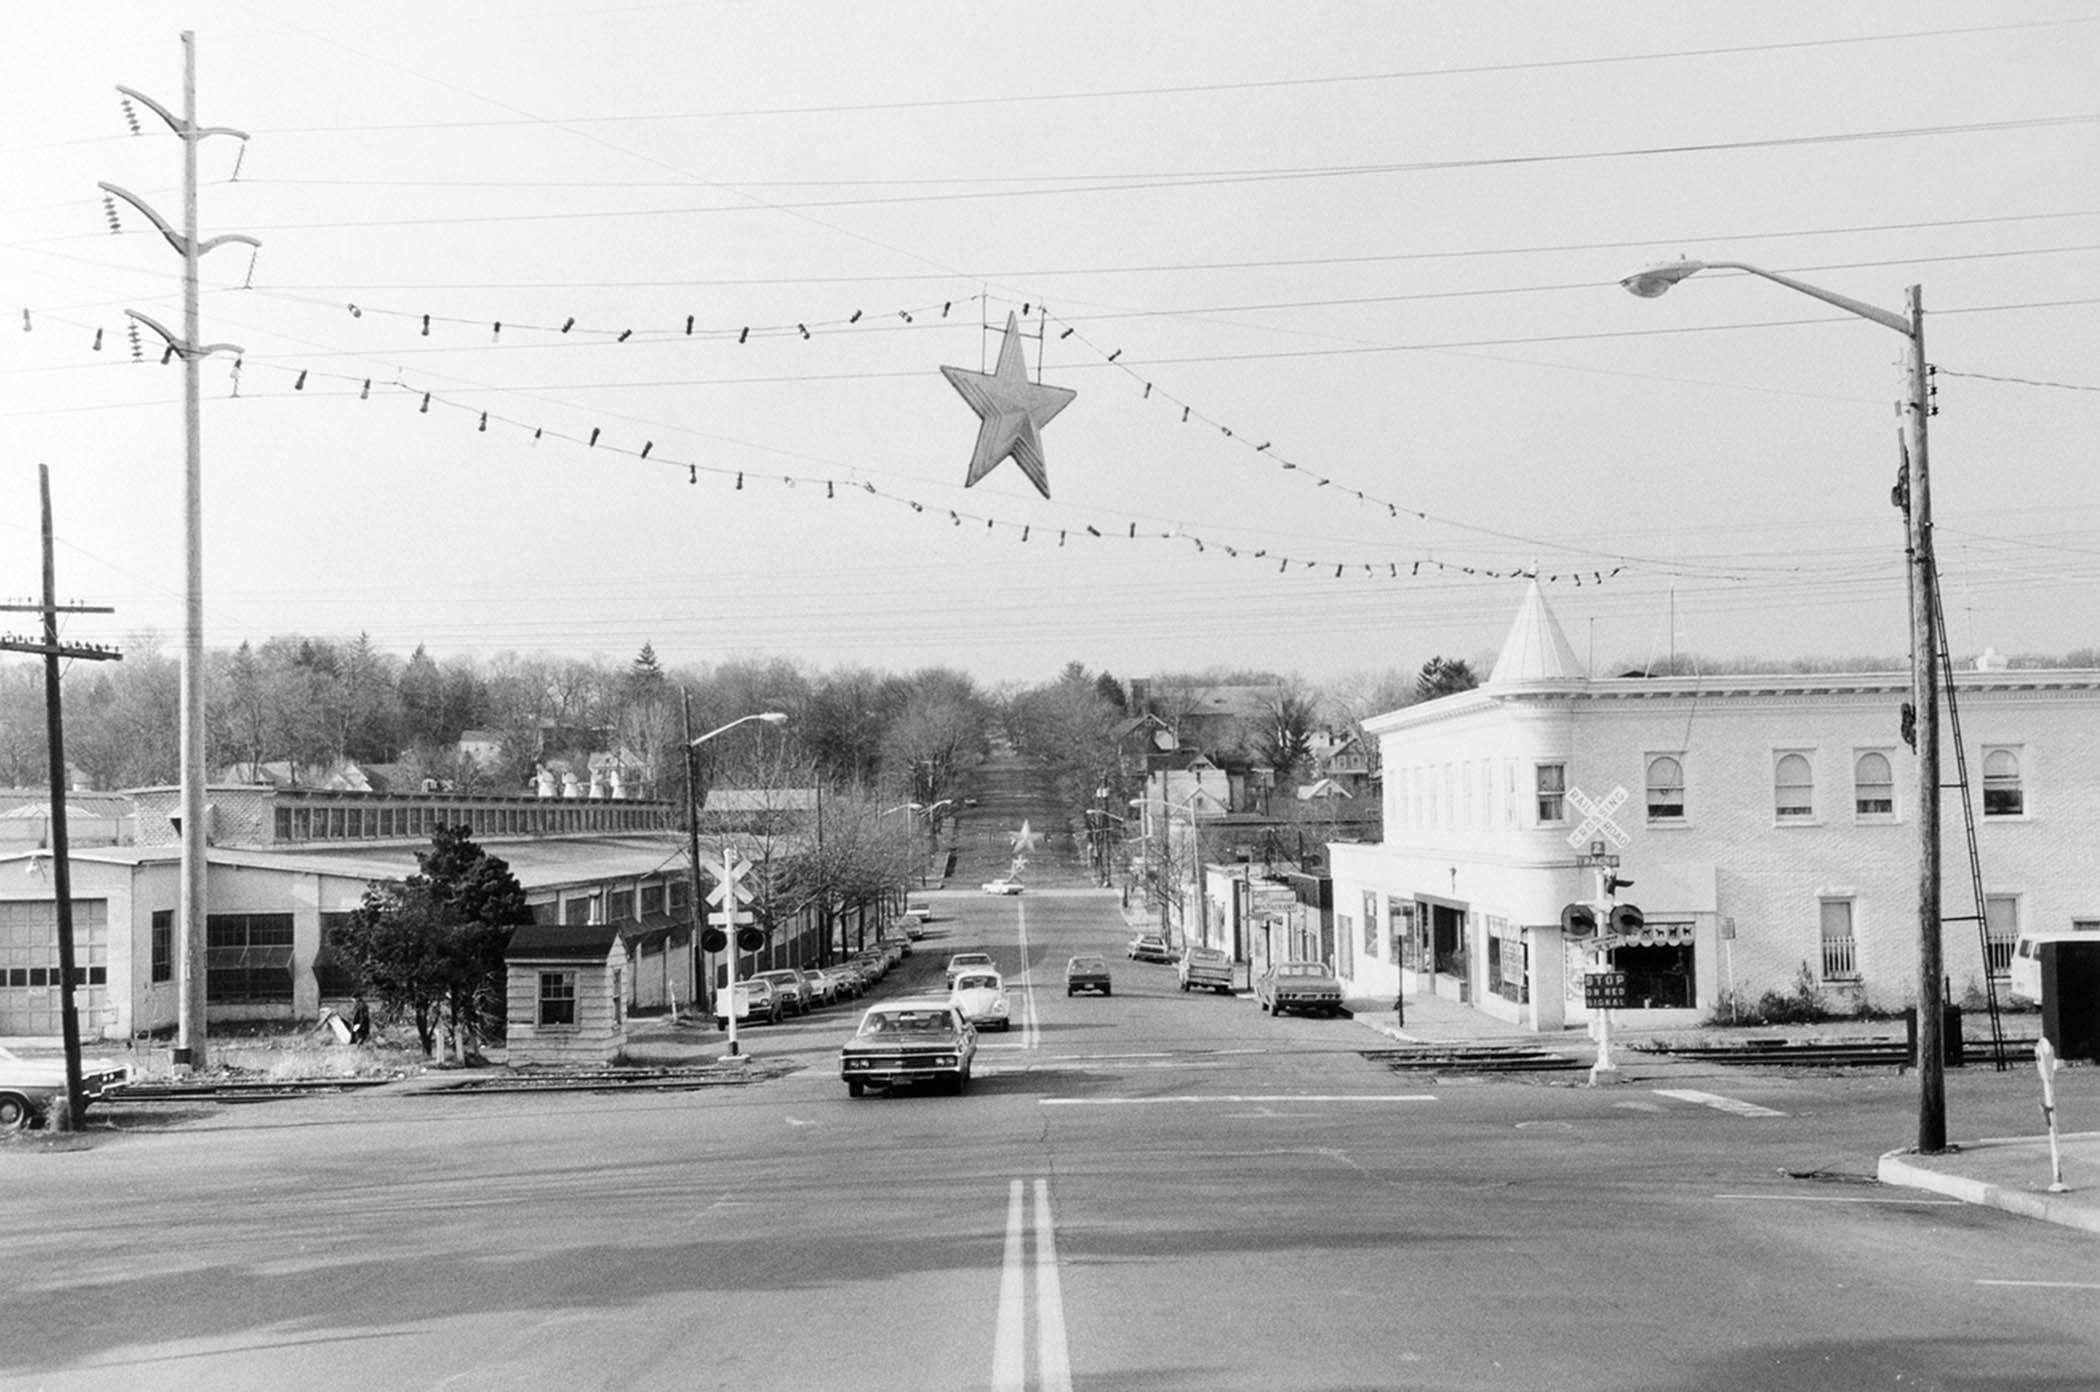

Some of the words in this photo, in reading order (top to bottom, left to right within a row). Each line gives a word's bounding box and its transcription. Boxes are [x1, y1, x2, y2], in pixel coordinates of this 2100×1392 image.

[1571, 790, 1625, 845] CROSSING
[1593, 842, 1602, 854] 2
[1577, 856, 1618, 866] TRACKS
[1586, 975, 1624, 986] STOP
[1586, 987, 1600, 996] ON
[1604, 987, 1625, 996] RED
[1587, 998, 1624, 1007] SIGNAL
